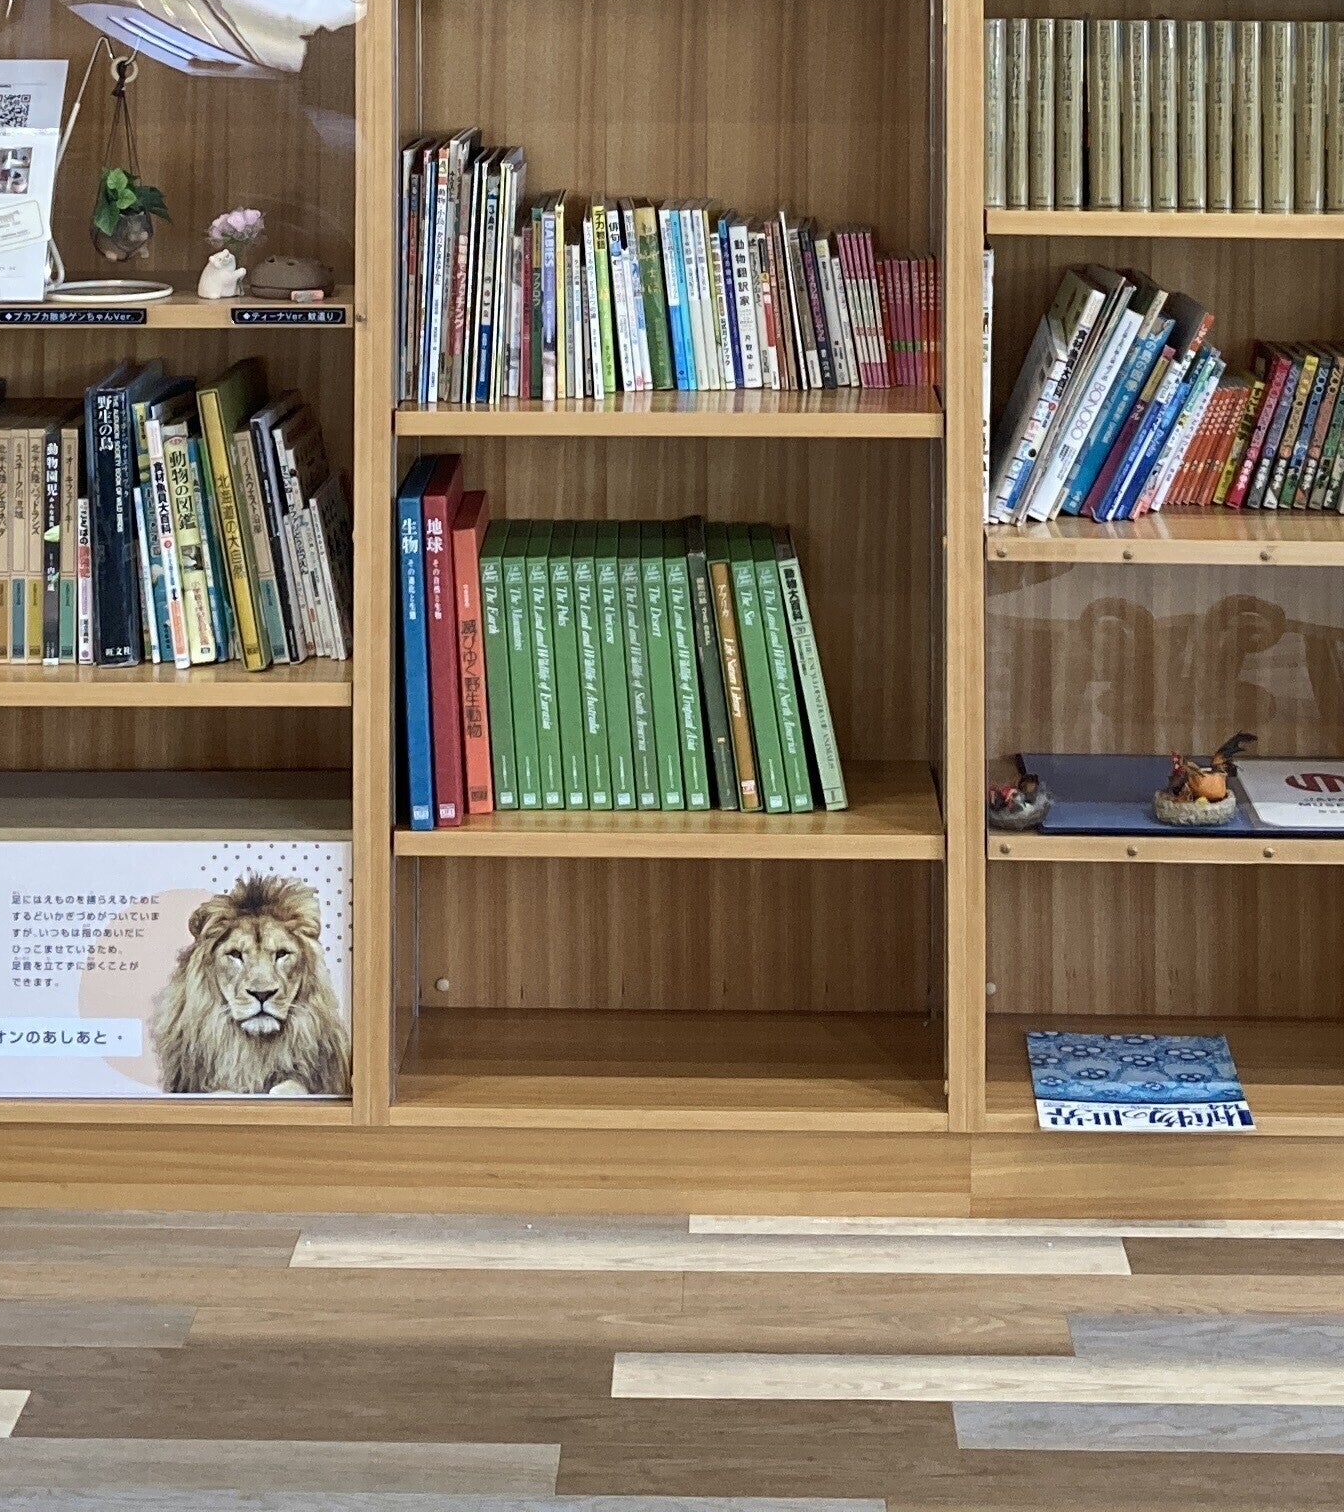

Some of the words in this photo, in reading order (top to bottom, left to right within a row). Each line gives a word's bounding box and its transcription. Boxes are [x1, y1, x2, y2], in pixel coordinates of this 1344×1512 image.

[733, 239, 750, 306] 動物翻訳家
[1070, 381, 1105, 441] BONOBO
[46, 442, 58, 496] 動物園児
[168, 450, 197, 530] 動物の図鑑
[401, 518, 419, 554] 生物
[426, 517, 444, 554] 地球
[12, 978, 59, 987] できます。
